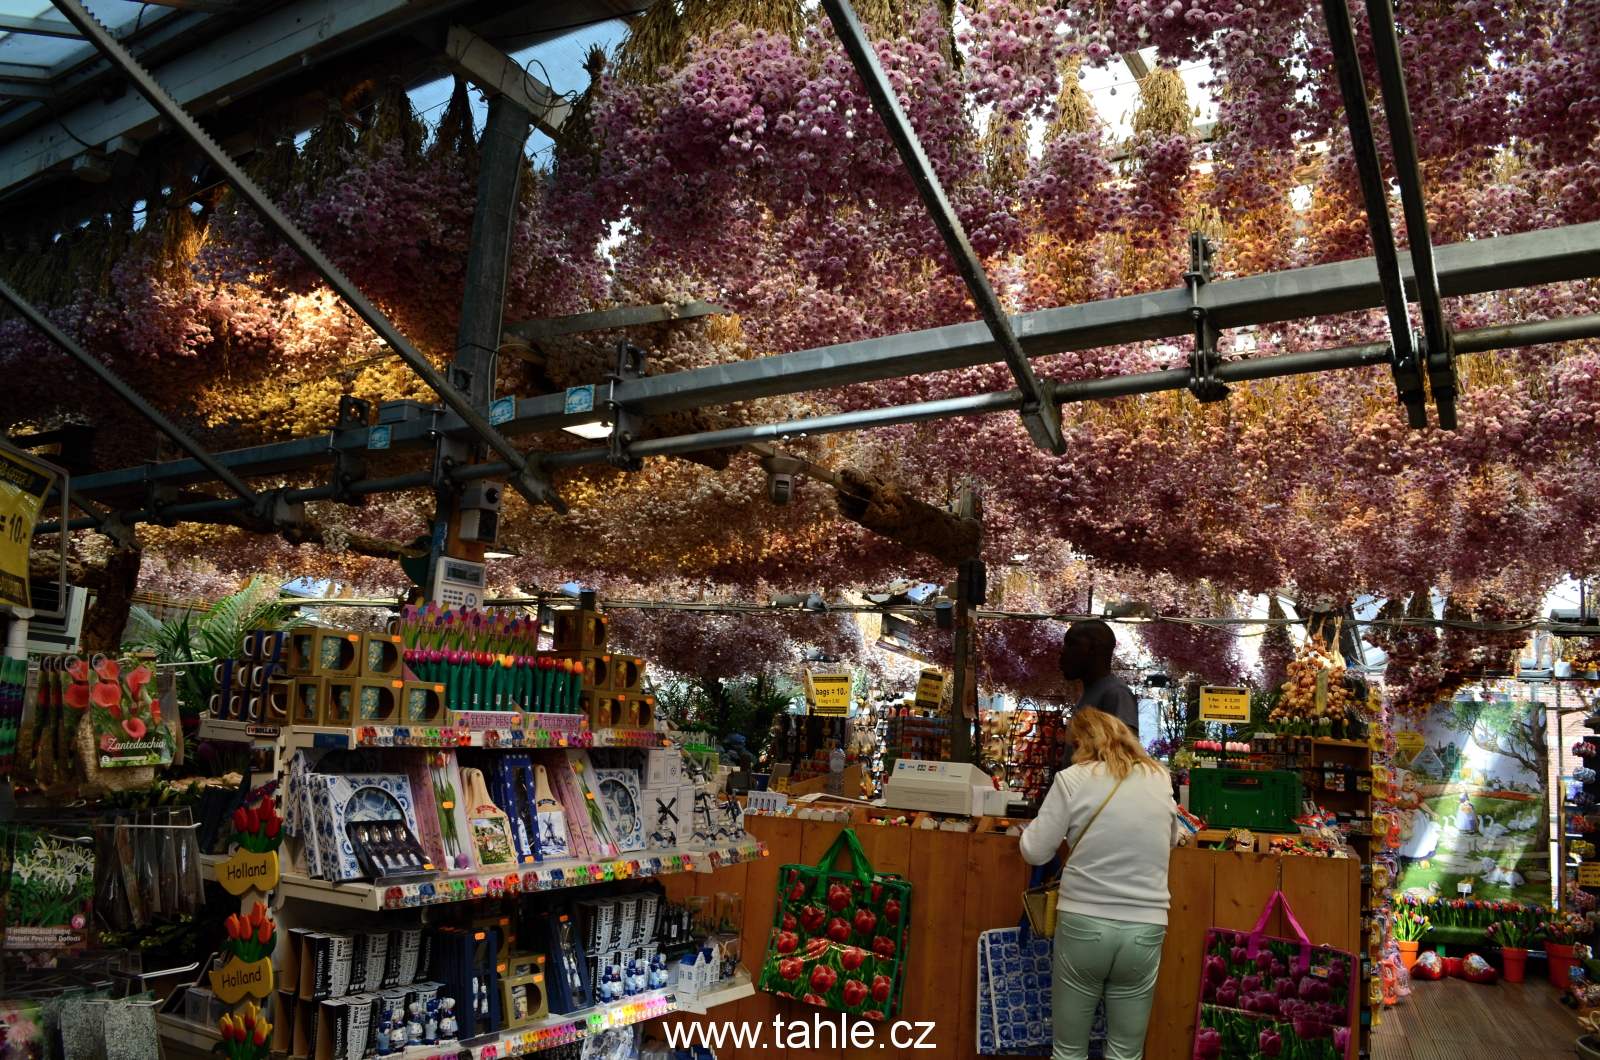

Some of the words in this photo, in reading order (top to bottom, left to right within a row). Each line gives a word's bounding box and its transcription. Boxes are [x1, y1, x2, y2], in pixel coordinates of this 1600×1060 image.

[816, 688, 830, 697] bags
[470, 718, 492, 726] TULIP
[495, 718, 510, 726] PEN
[544, 718, 563, 727] TULIP
[565, 719, 578, 727] PEN
[108, 736, 166, 750] Zantedeschia
[906, 796, 946, 804] SHARP
[227, 860, 267, 880] Holland
[423, 936, 432, 972] AMSTERDAM
[222, 966, 261, 989] Holland
[316, 949, 324, 990] AMSTERDAM
[334, 1017, 343, 1056] AMSTERDAM
